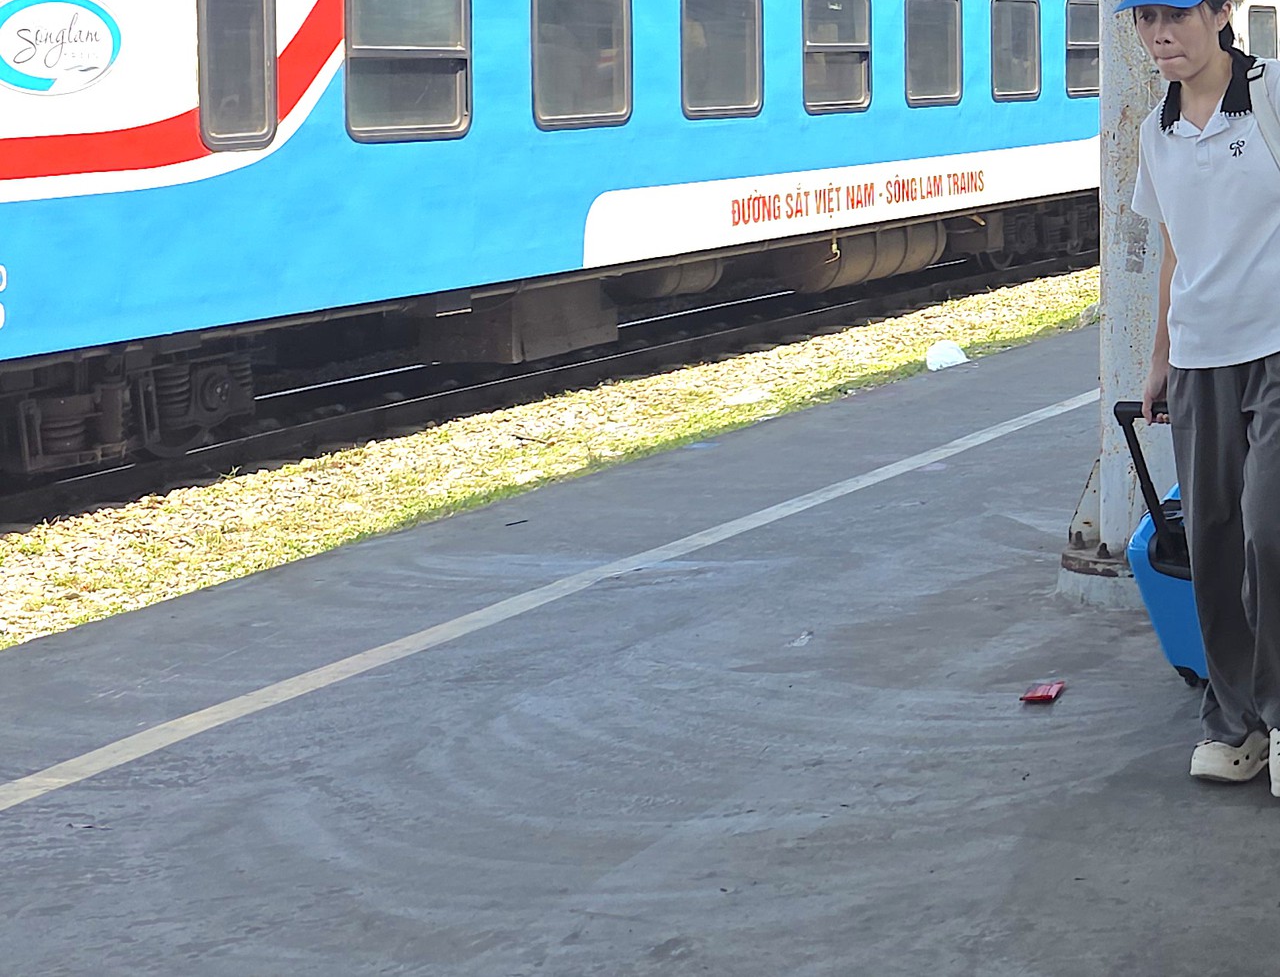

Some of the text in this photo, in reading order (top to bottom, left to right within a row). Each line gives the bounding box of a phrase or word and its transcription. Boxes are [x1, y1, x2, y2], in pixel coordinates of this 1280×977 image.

[731, 189, 781, 227] ĐƯỜNG
[785, 182, 811, 220] SẮT
[814, 182, 842, 219] VIỆT
[846, 182, 875, 211] NAM
[885, 174, 918, 204] SÔNG
[919, 174, 943, 200] LAM
[946, 170, 985, 197] TRAINS
